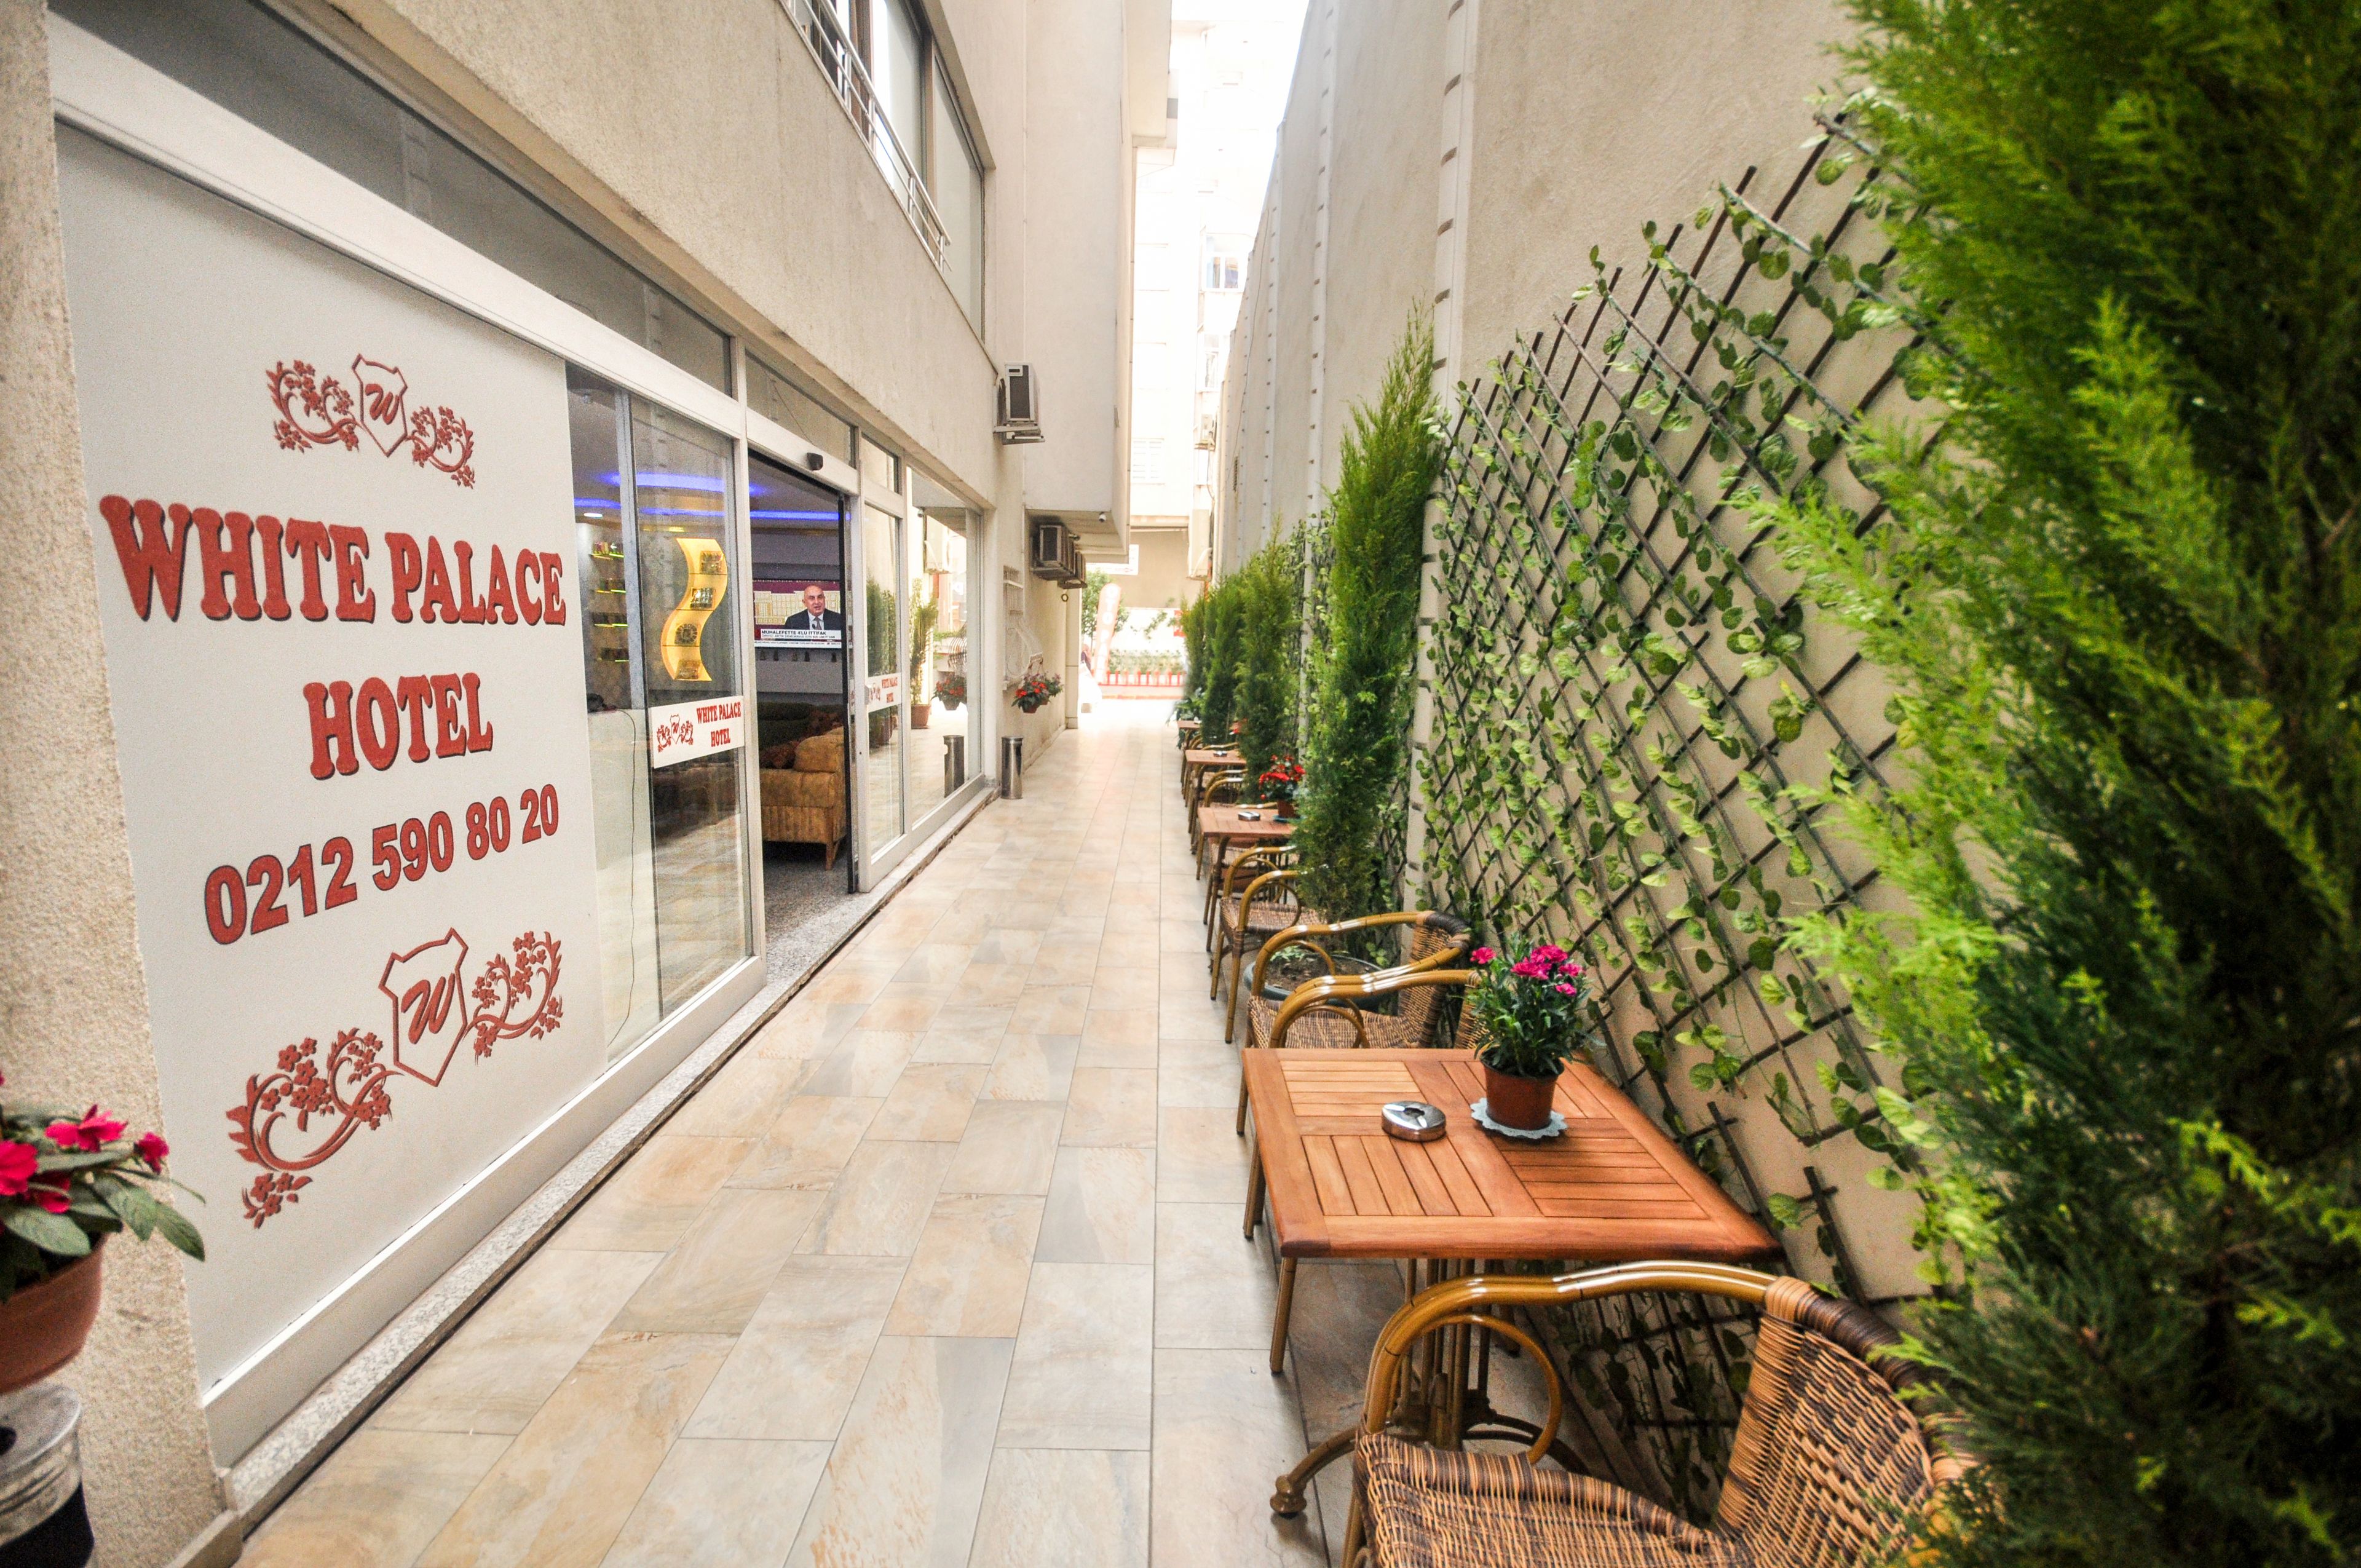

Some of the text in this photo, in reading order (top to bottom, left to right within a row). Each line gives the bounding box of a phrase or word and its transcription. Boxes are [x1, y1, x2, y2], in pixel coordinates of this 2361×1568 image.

[99, 494, 566, 627] WHITE PALACE
[303, 671, 494, 781] HOTEL
[696, 702, 742, 724] WHITE PALACE
[710, 727, 731, 747] HOTEL
[204, 783, 560, 945] 0212 590 80 20
